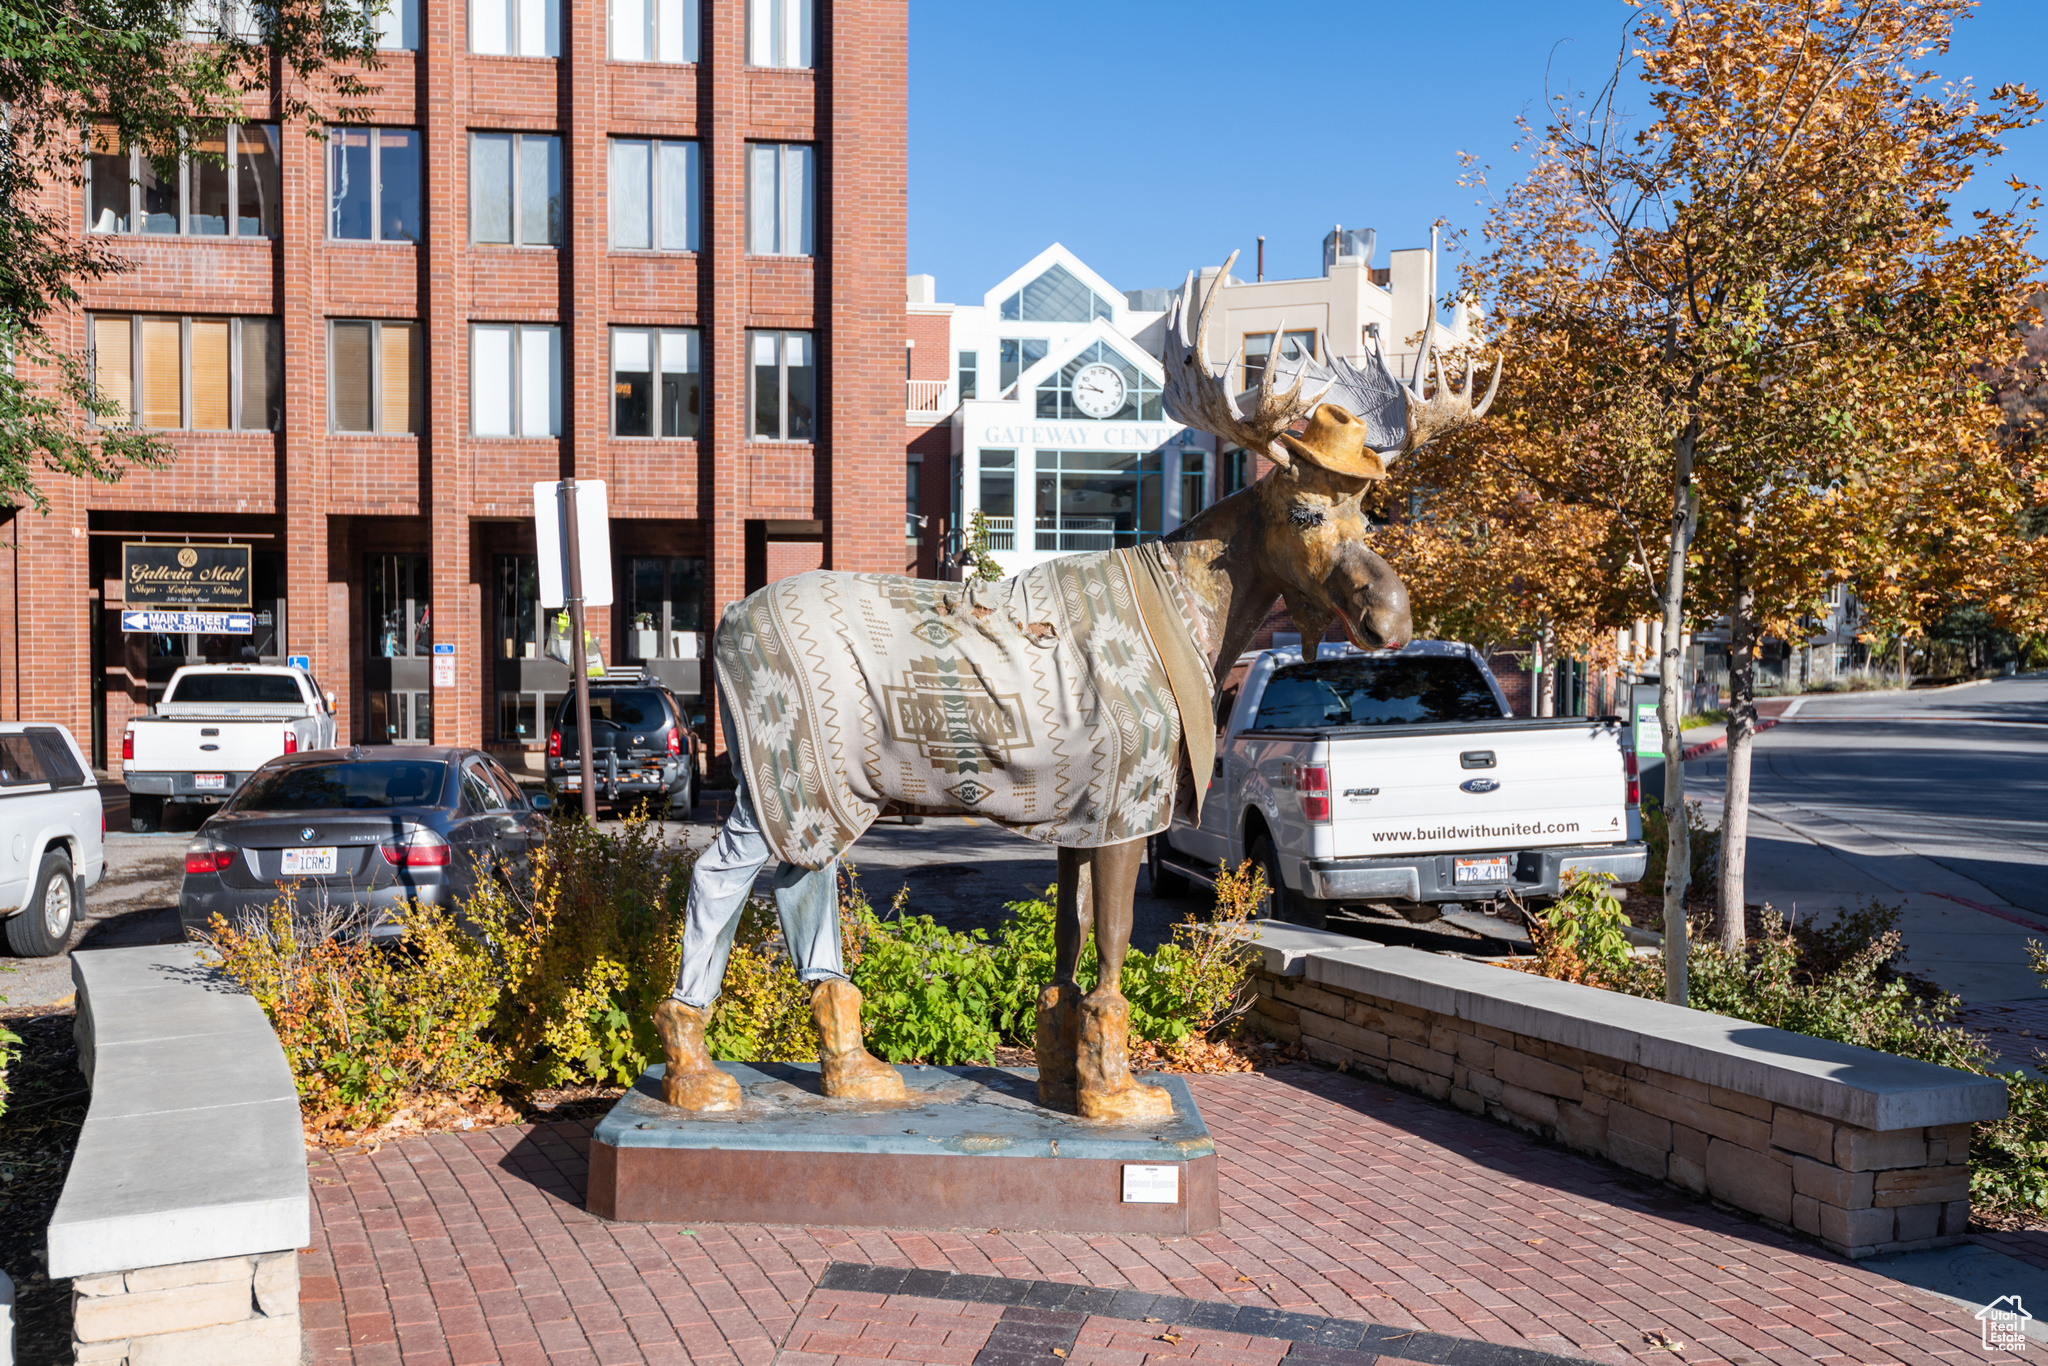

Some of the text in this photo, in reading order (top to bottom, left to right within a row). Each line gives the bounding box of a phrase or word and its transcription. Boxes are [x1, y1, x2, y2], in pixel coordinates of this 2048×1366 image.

[985, 426, 1195, 446] GATEWAY CENTER
[129, 564, 245, 584] Galleria Mall
[132, 584, 242, 597] Shops Lodging Dining
[149, 613, 228, 626] MAIN STREET
[205, 624, 228, 632] MALL
[1611, 817, 1618, 826] 4
[1372, 821, 1580, 842] www.buildwithunited.com
[300, 856, 331, 870] 1CRM3
[1485, 865, 1506, 880] 4YH
